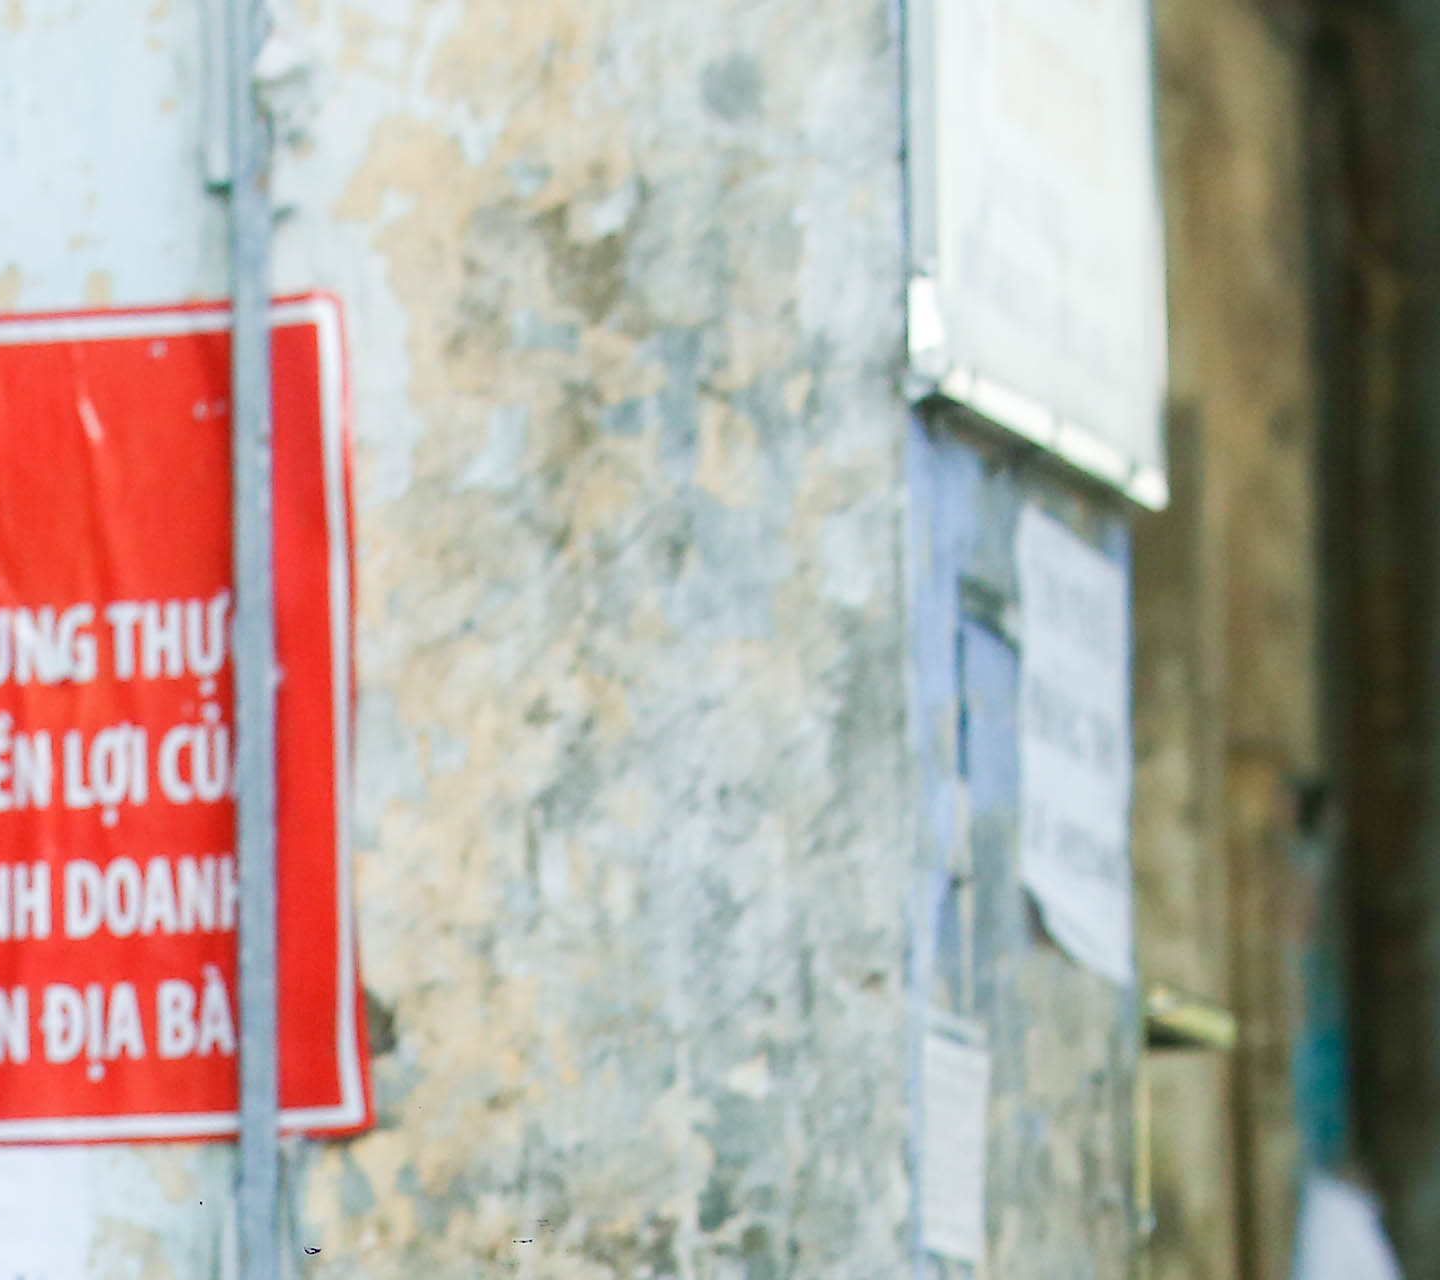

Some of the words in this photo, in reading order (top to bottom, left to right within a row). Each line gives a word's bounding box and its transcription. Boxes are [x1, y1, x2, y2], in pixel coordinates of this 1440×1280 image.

[106, 588, 233, 697] THỰ
[62, 721, 149, 828] LỢI
[158, 700, 233, 802] CỦ
[39, 980, 145, 1083] ĐỊA
[156, 963, 238, 1060] BÀ
